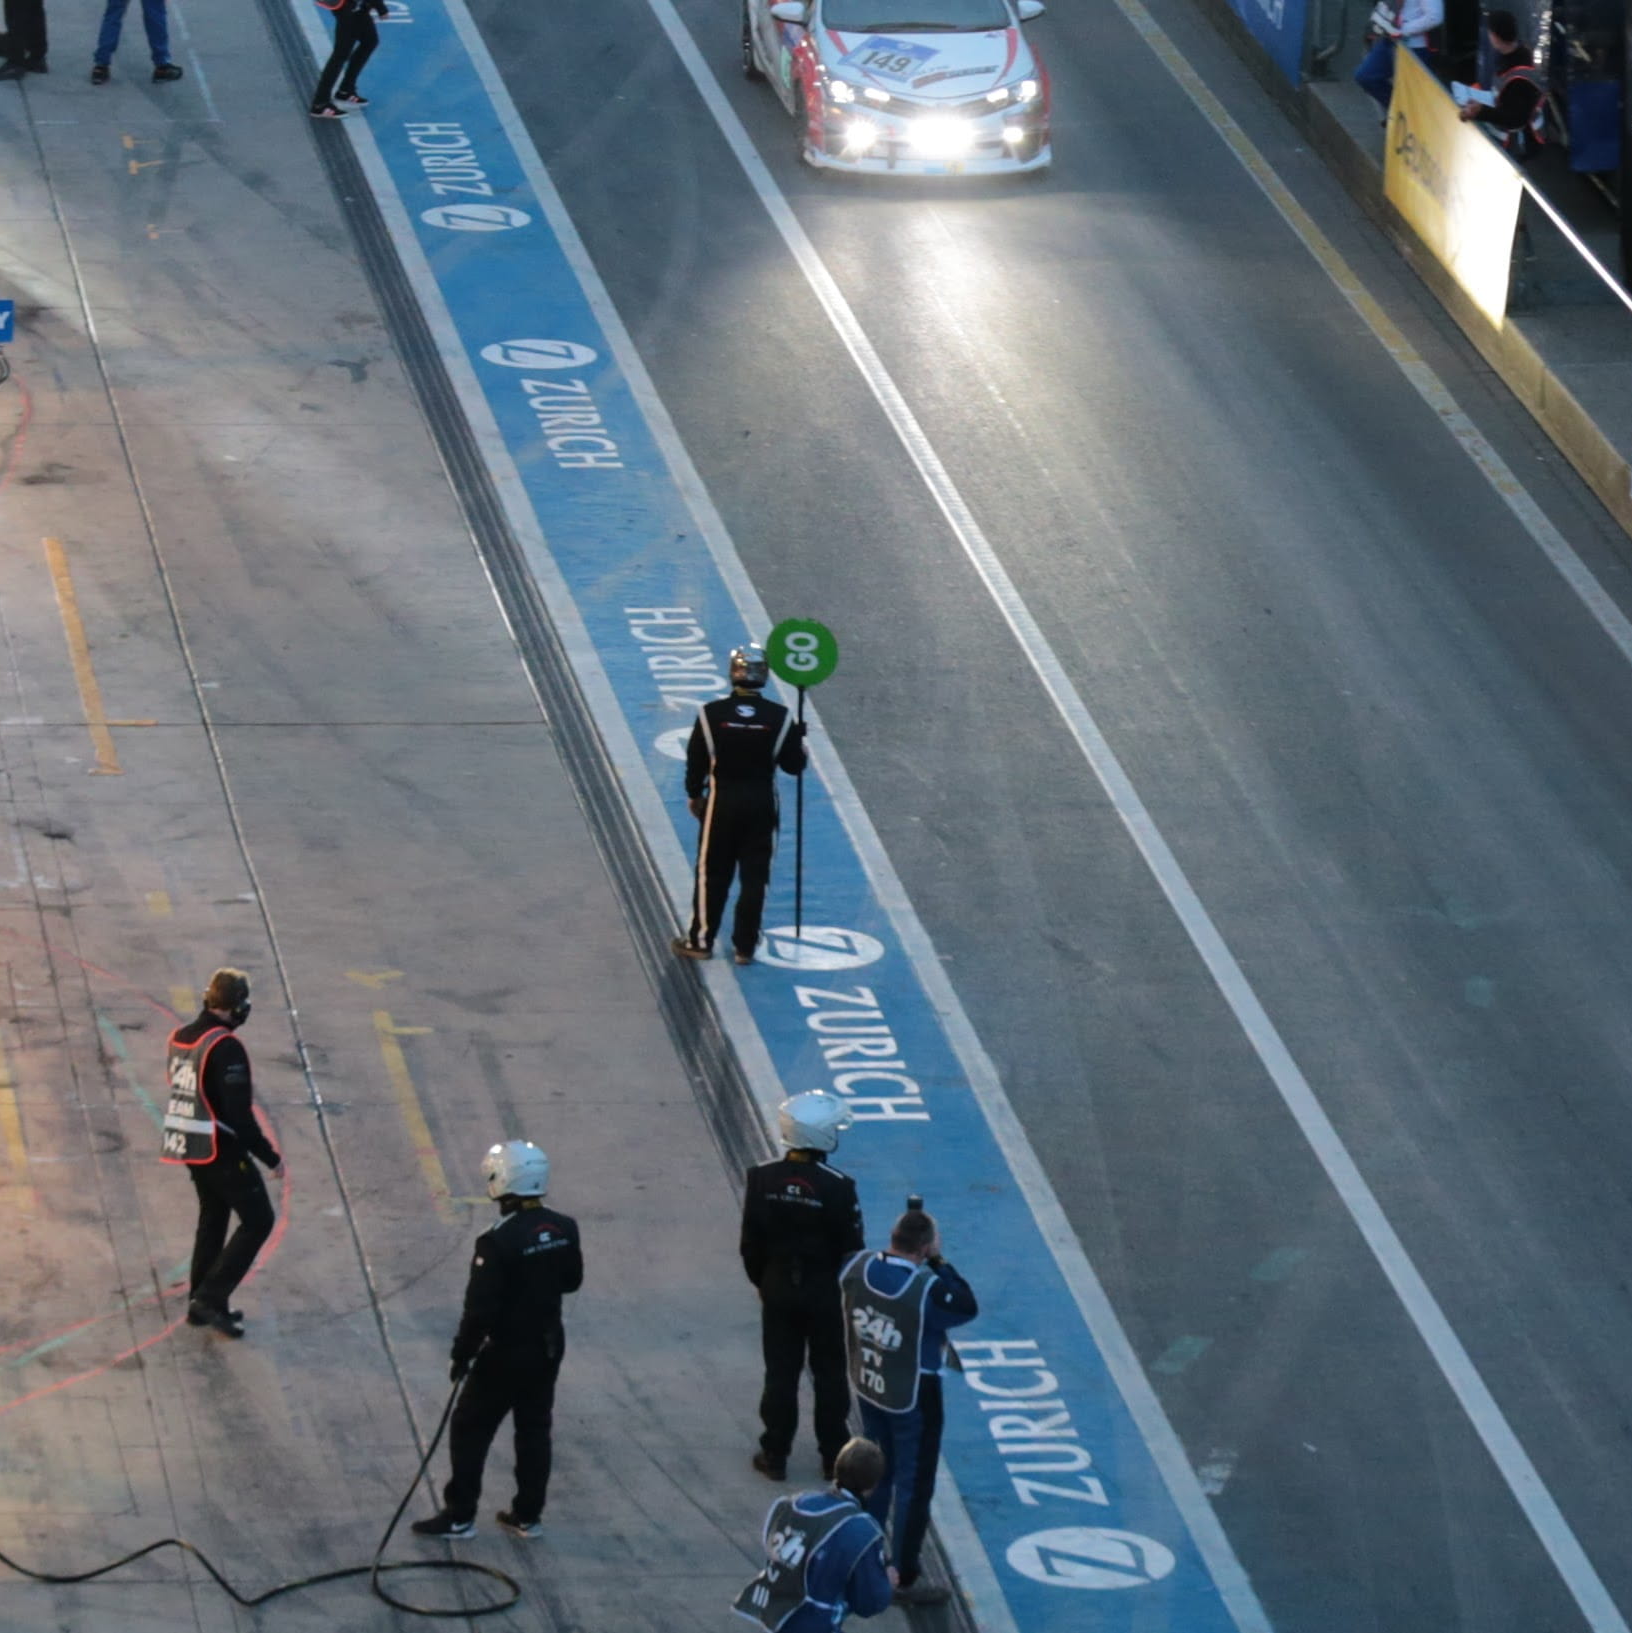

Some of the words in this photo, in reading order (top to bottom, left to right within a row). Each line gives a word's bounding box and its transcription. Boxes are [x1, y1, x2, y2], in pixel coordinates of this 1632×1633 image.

[861, 50, 912, 73] 149
[405, 122, 493, 197] ZURICH
[519, 378, 624, 469] ZURICH
[623, 606, 730, 713] ZURICH
[785, 631, 819, 672] GO
[794, 985, 931, 1123] ZURICH
[852, 1307, 903, 1348] 24h
[860, 1366, 885, 1394] 170
[861, 1347, 883, 1367] TV
[952, 1339, 1109, 1506] ZURICH
